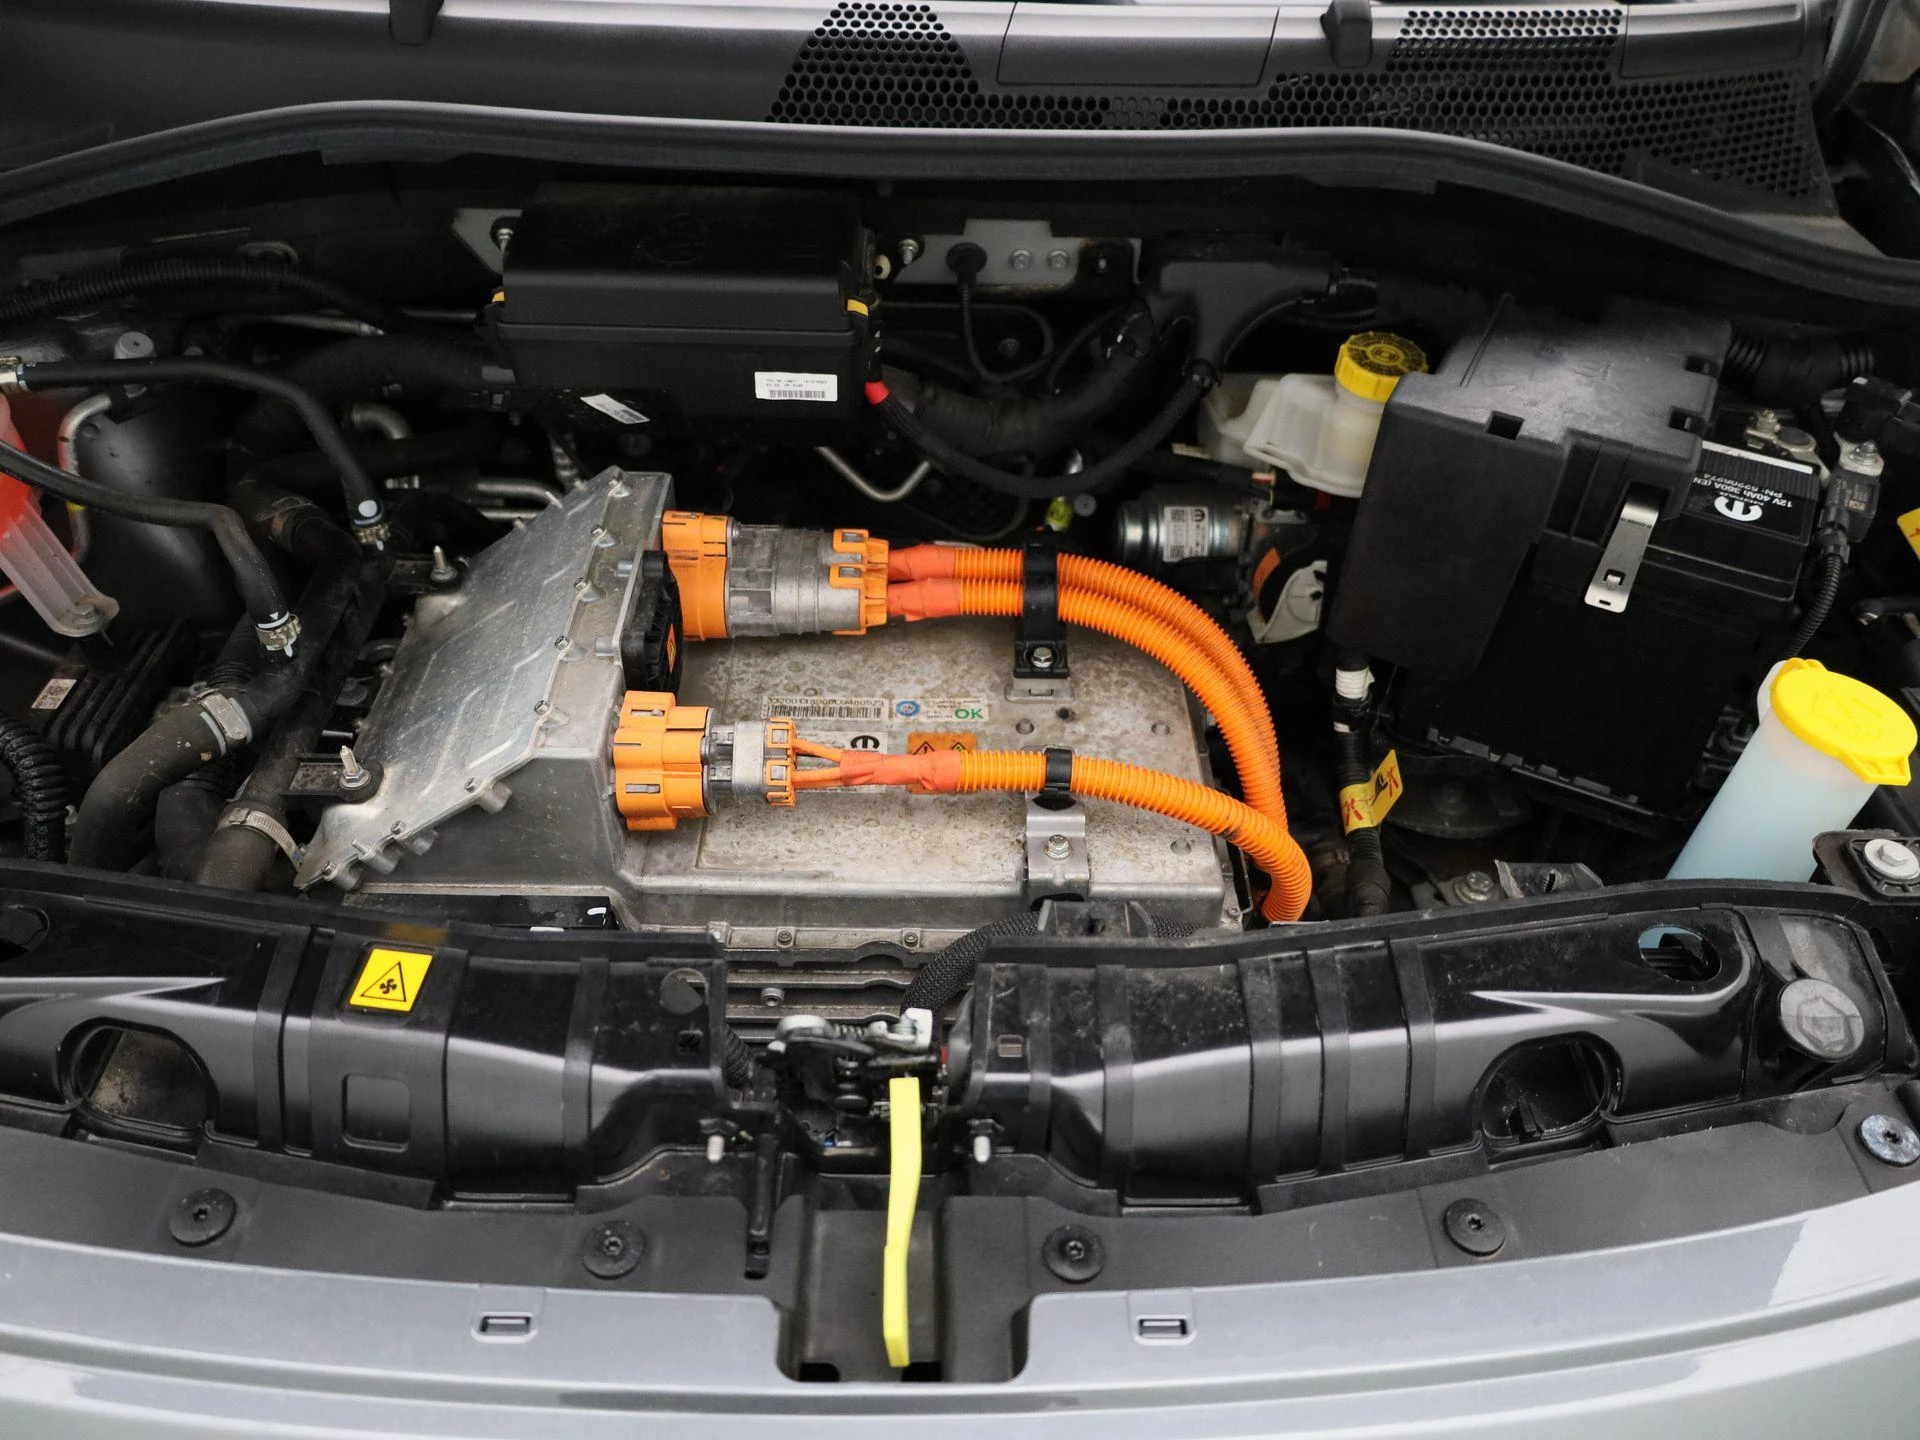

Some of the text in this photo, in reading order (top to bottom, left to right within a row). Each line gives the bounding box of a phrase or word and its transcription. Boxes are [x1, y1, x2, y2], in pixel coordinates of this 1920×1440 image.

[1743, 489, 1771, 502] 40Ah
[1772, 498, 1793, 508] 12V
[954, 708, 984, 719] OK
